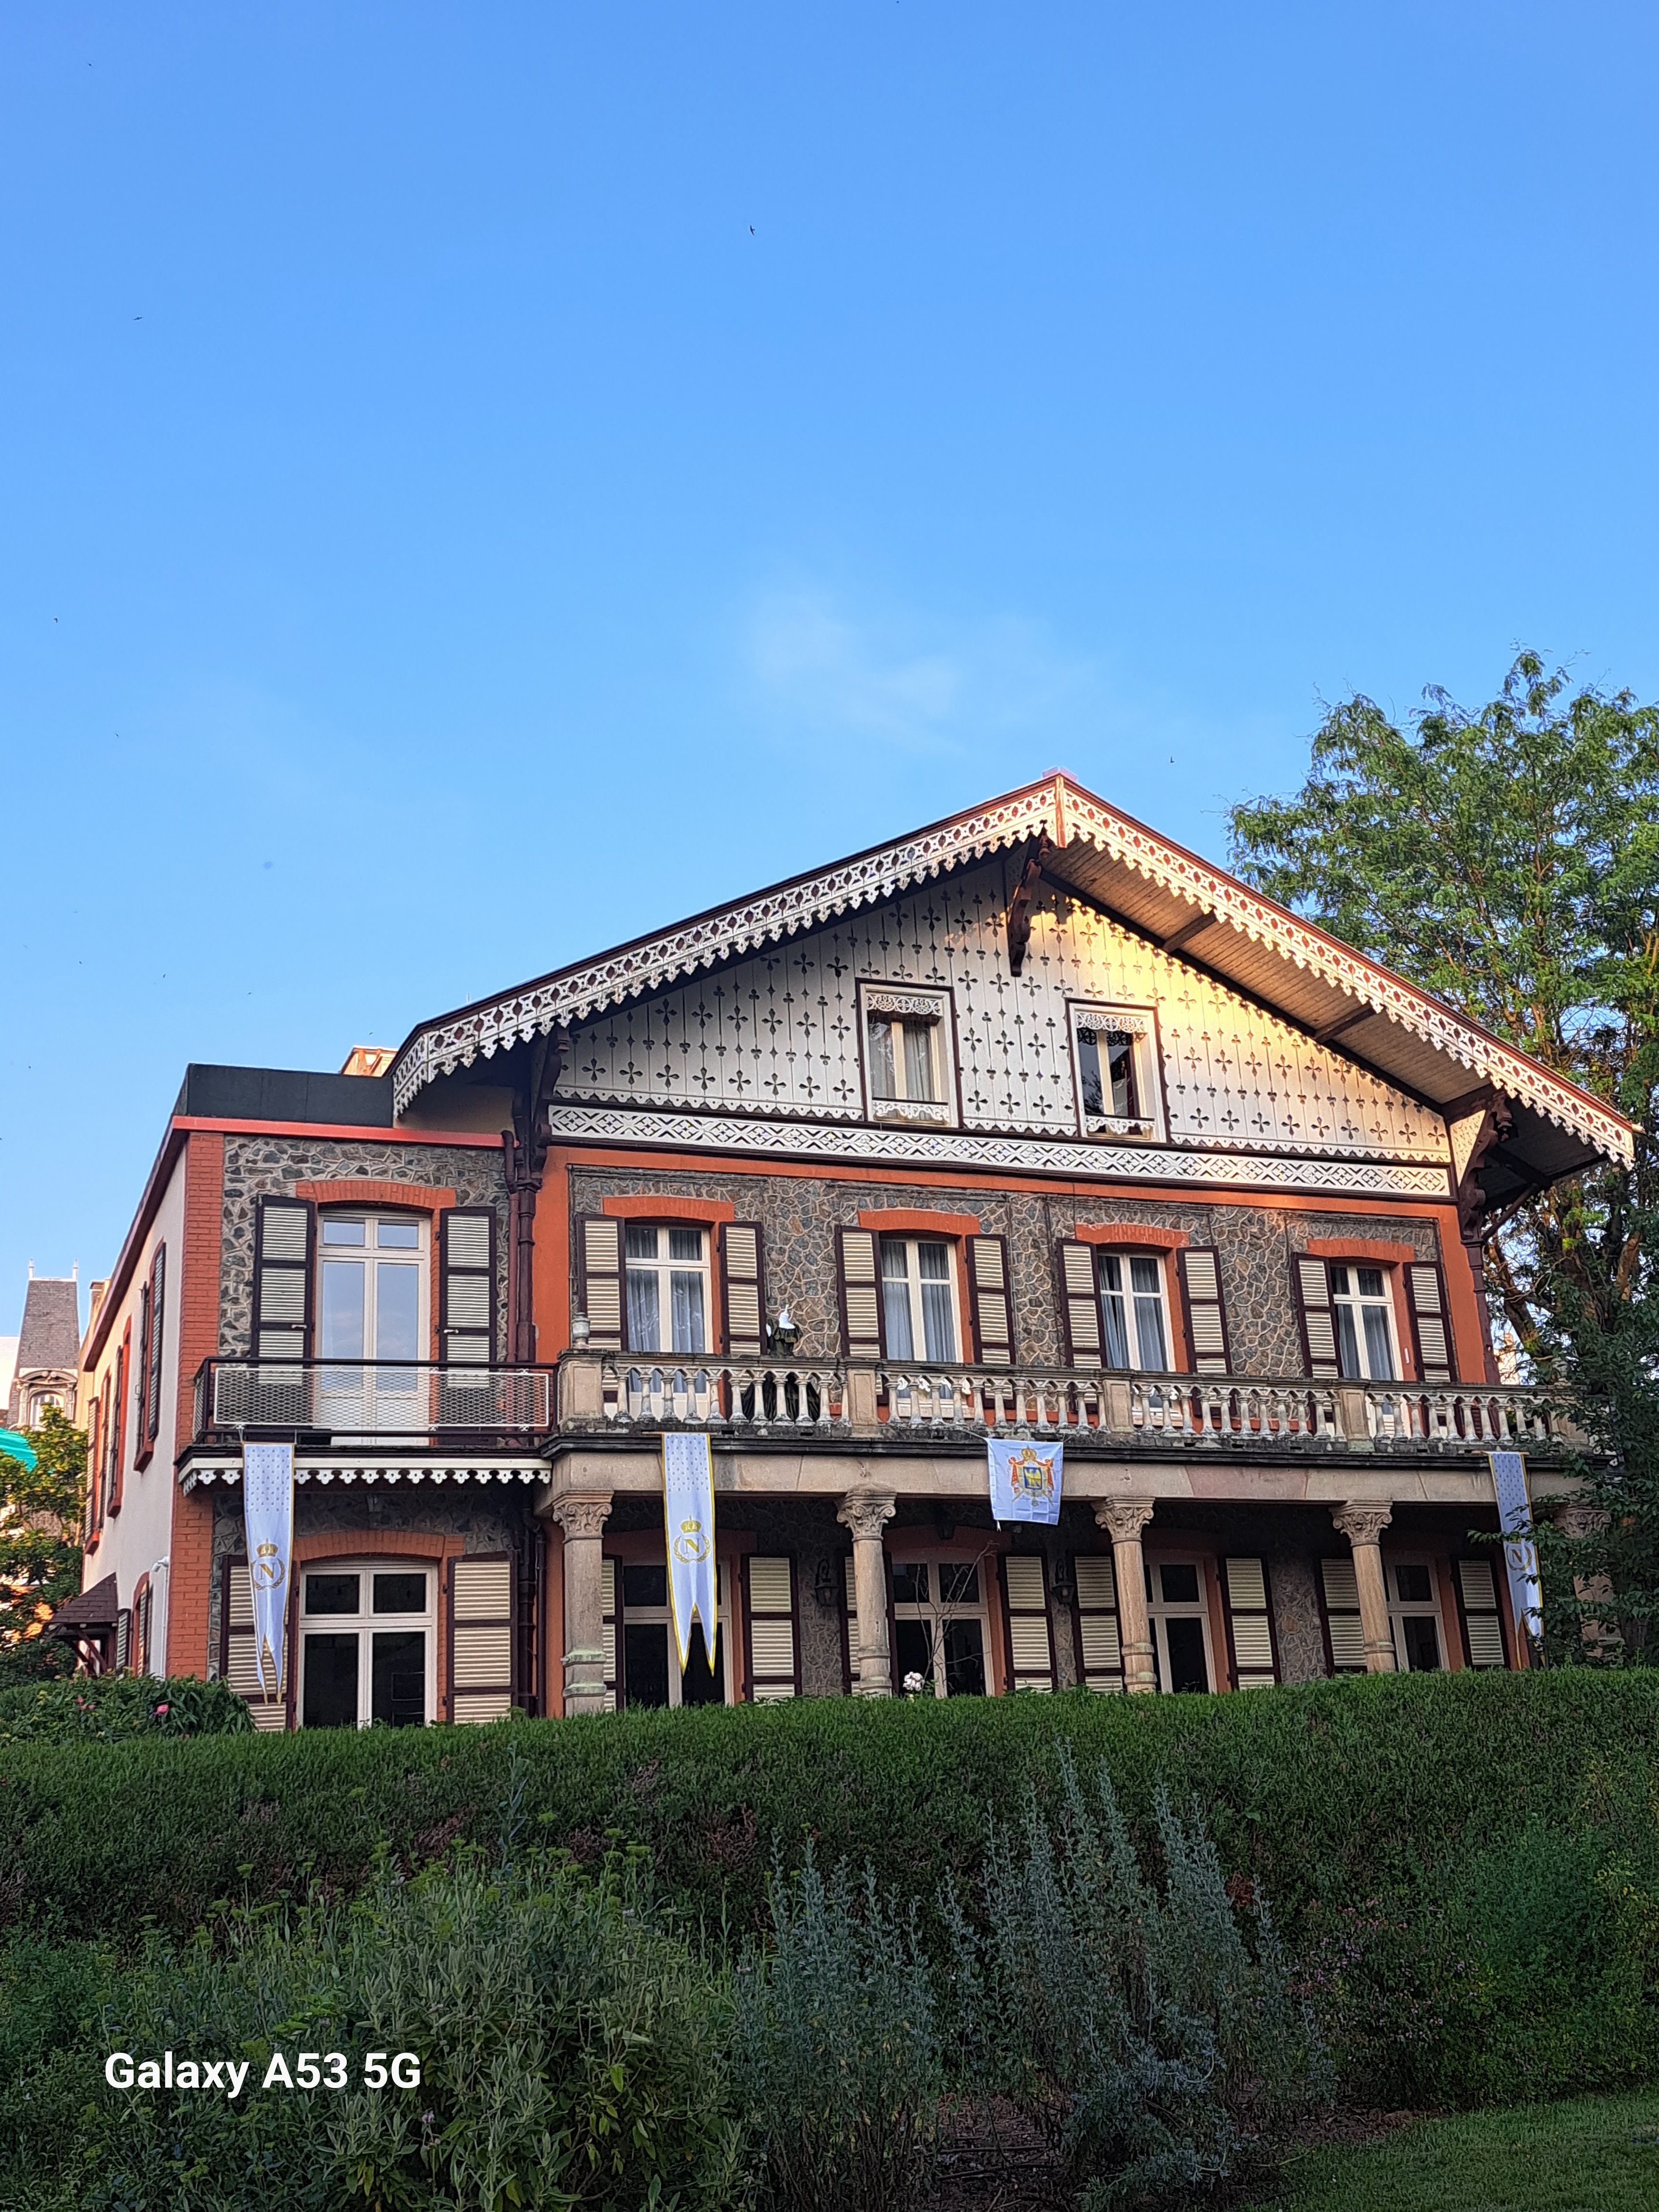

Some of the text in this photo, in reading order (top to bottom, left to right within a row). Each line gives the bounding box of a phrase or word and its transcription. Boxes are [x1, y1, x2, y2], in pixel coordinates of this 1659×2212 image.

[684, 1538, 700, 1554] N
[1511, 1548, 1523, 1563] N
[258, 1562, 276, 1580] N
